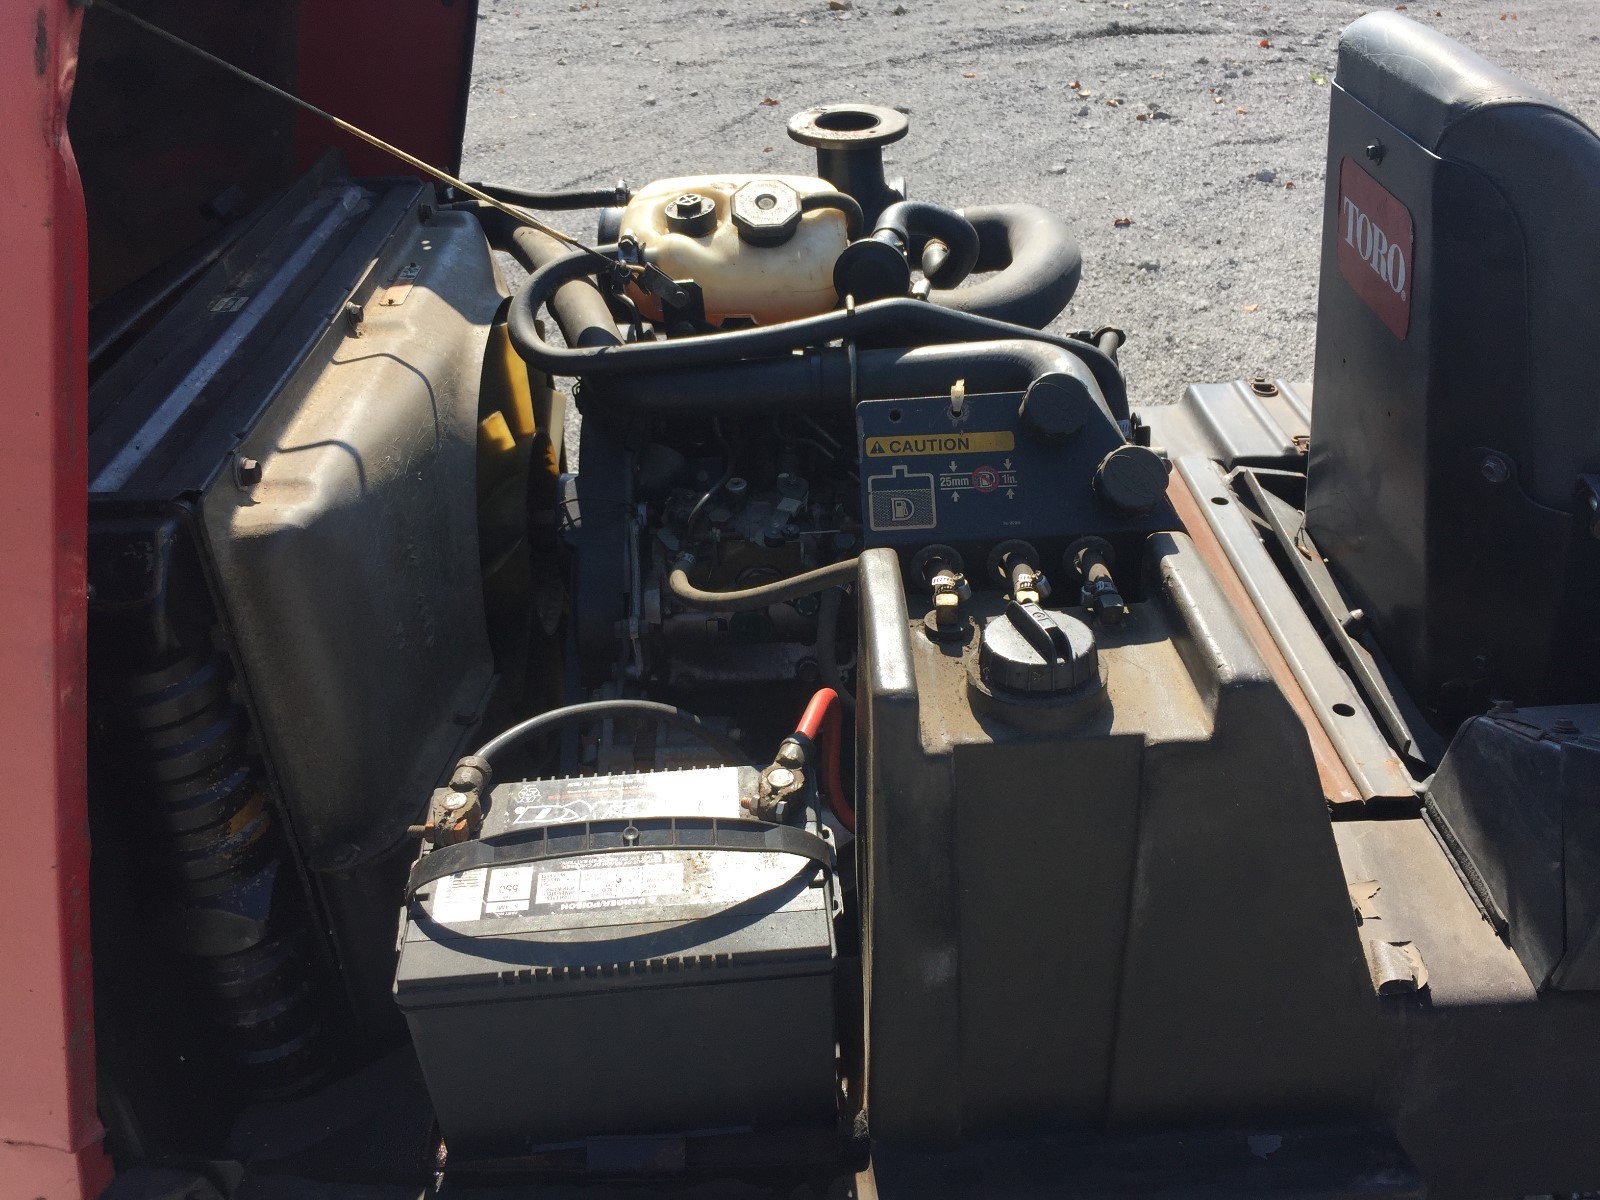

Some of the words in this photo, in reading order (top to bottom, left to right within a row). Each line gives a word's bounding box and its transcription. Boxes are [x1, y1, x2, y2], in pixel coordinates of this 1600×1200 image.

[1343, 196, 1406, 293] TORO
[889, 437, 970, 453] CAUTION
[939, 476, 970, 487] 25mm
[561, 897, 646, 910] DANGER/POISON
